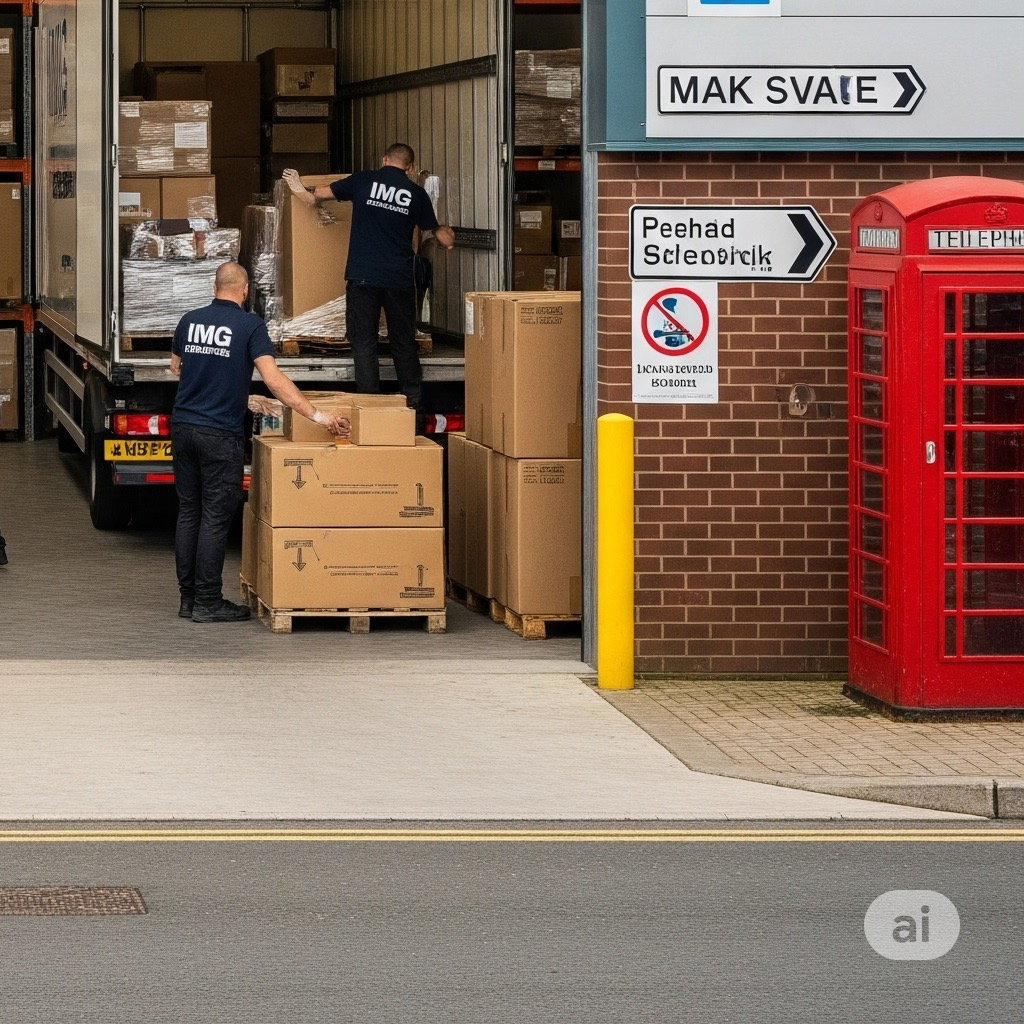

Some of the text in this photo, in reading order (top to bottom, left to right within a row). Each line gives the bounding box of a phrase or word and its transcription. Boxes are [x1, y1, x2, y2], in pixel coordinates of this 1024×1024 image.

[670, 75, 754, 105] MAK
[369, 181, 412, 207] IMG
[187, 322, 233, 347] IMG
